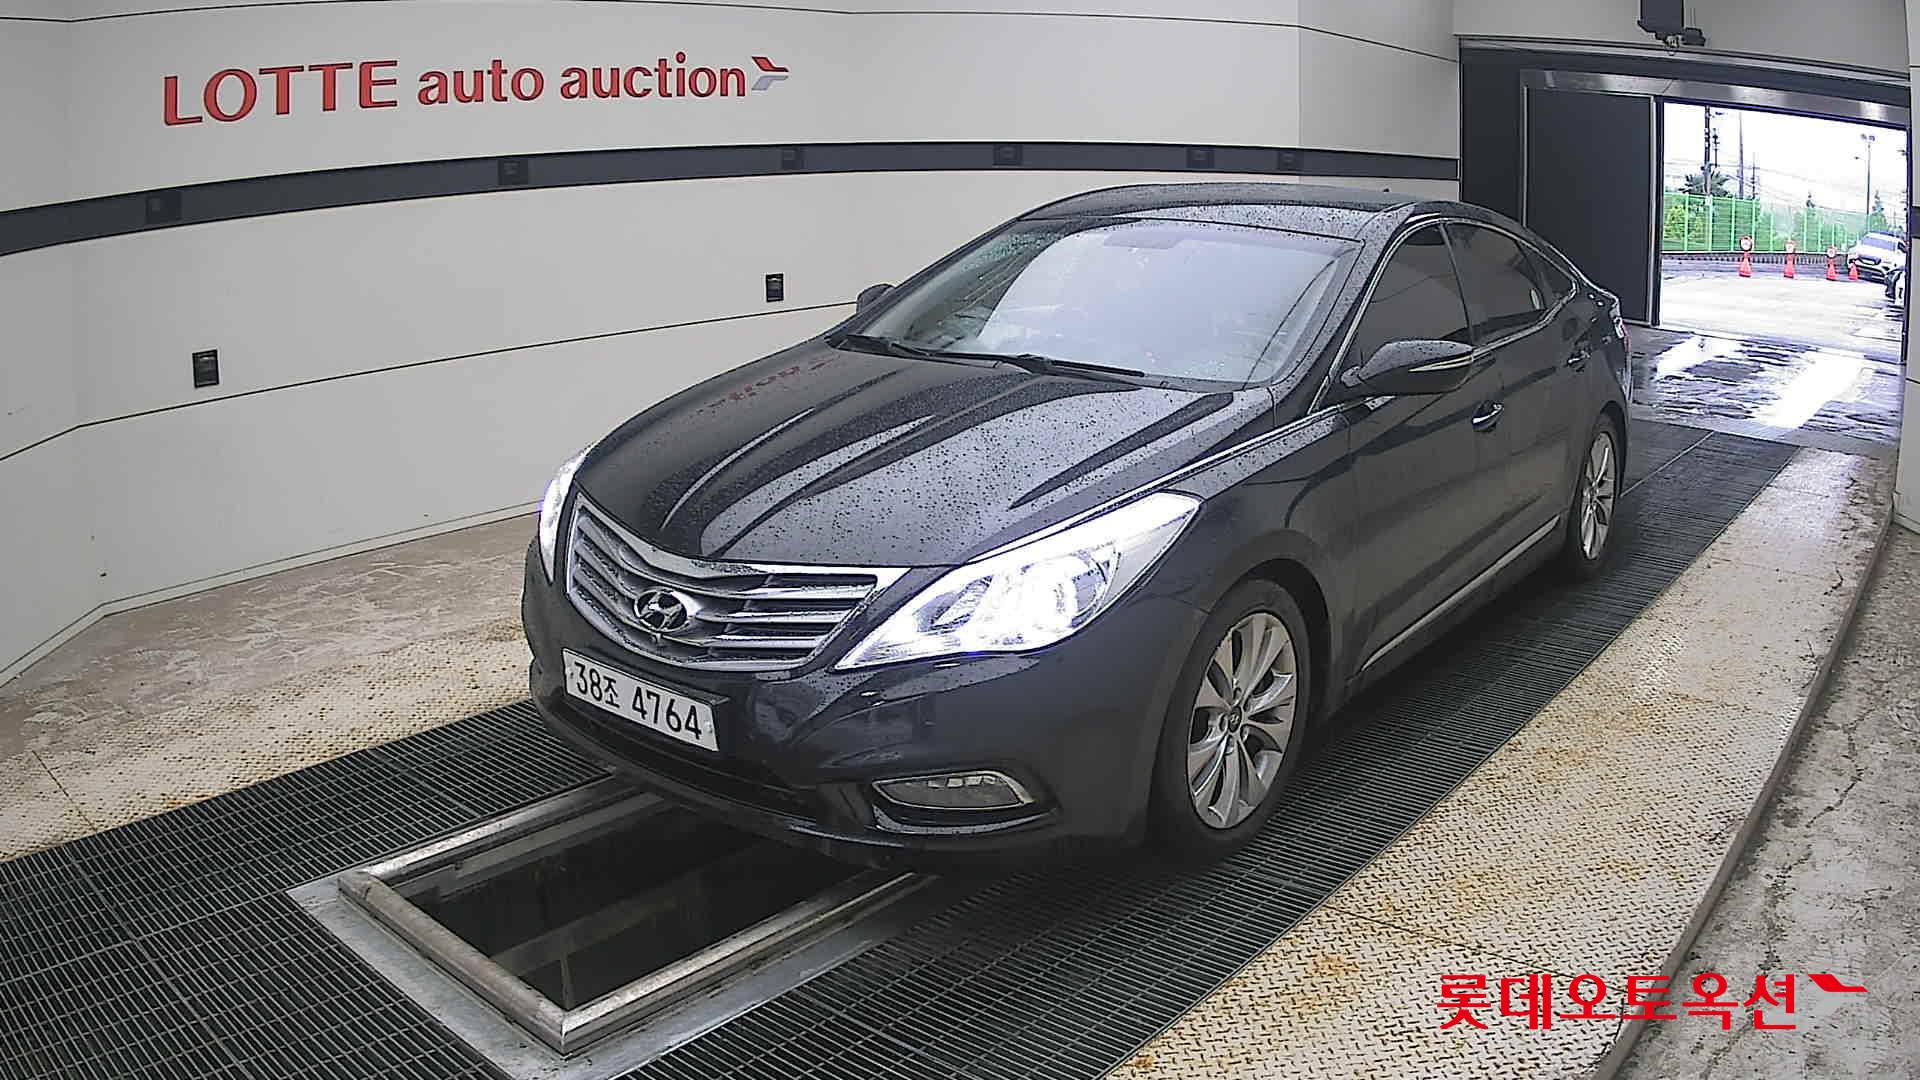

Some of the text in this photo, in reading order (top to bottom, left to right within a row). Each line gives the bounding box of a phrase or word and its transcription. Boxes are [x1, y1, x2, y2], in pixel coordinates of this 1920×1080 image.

[163, 51, 747, 126] LOTTE auto auction
[573, 660, 703, 741] 38조 4764
